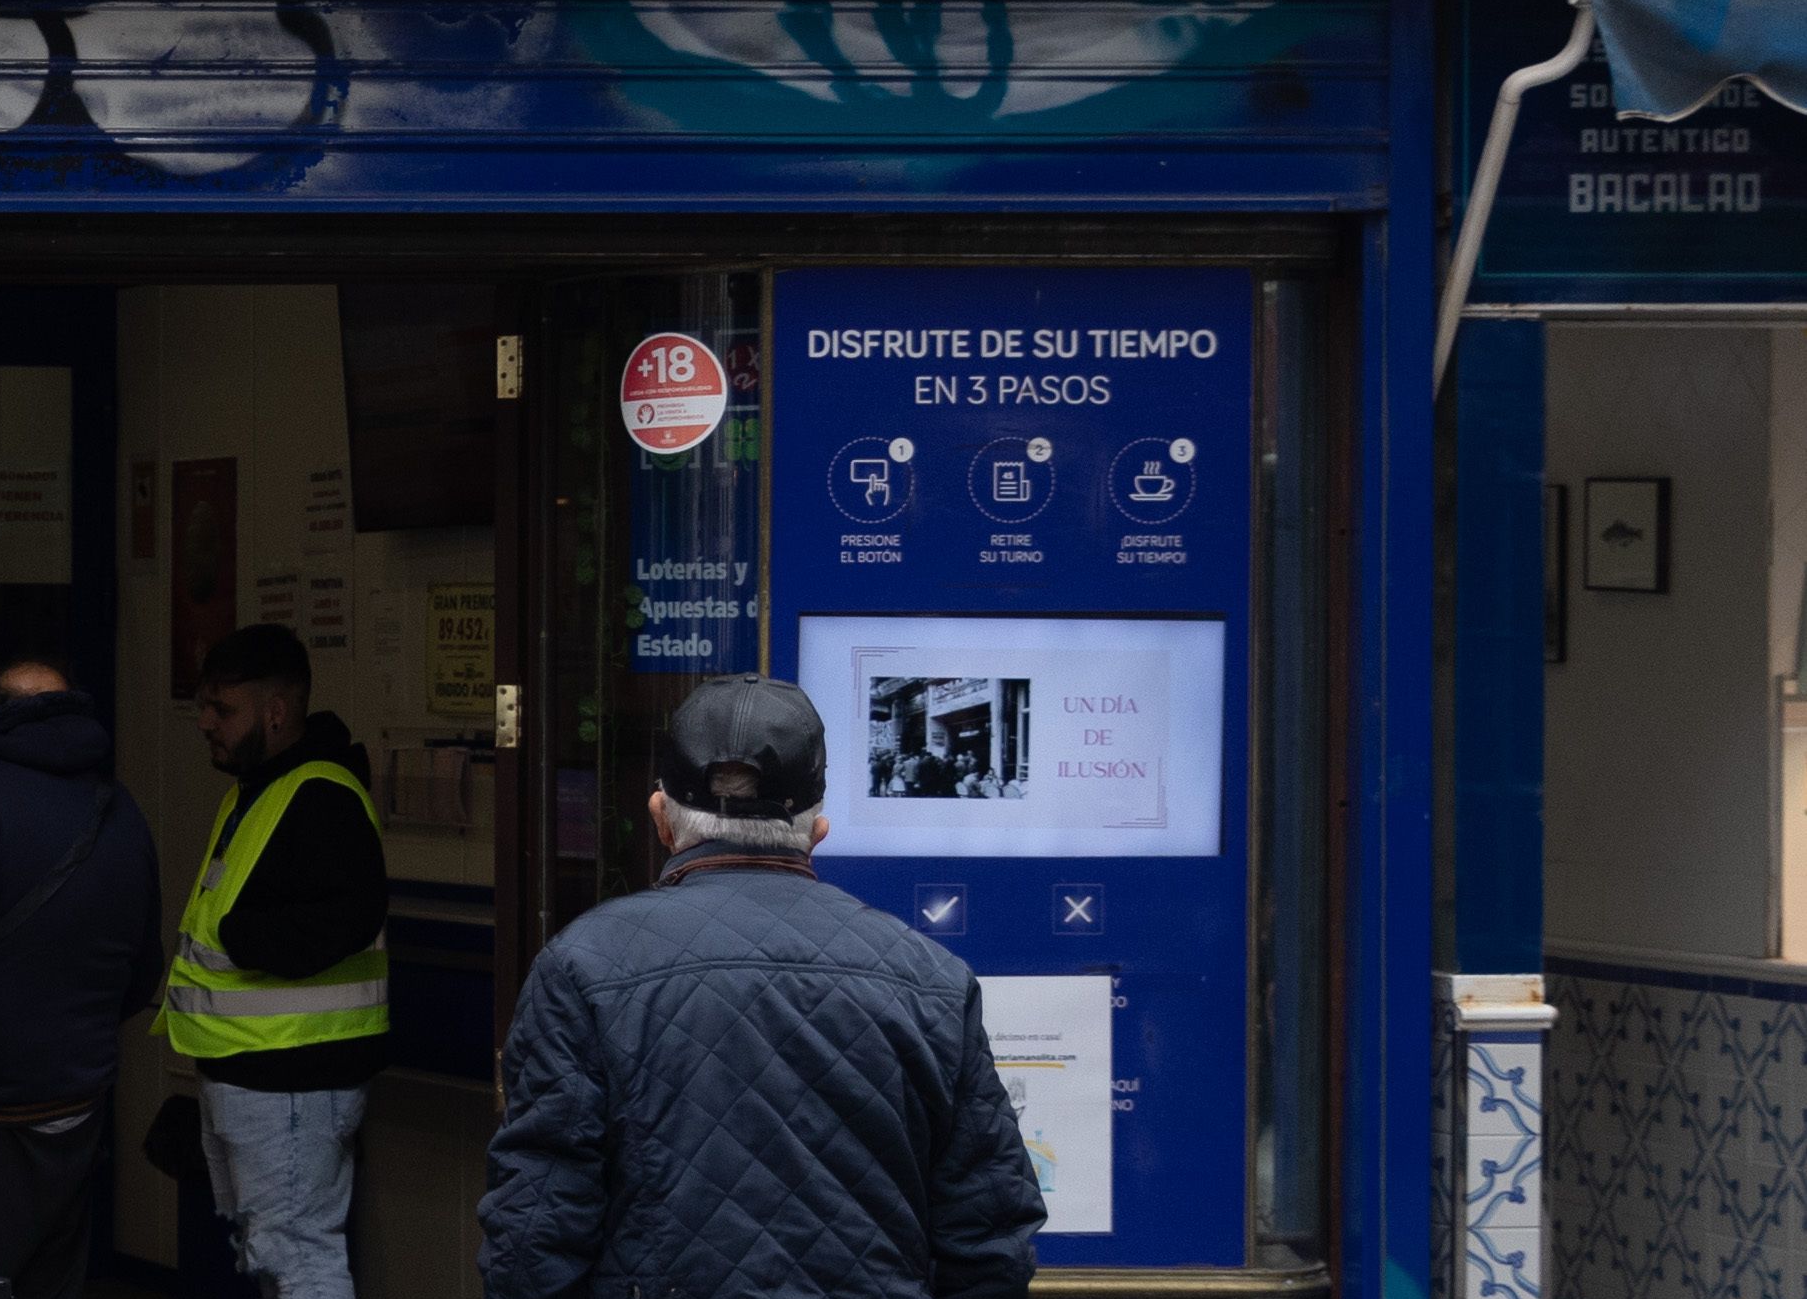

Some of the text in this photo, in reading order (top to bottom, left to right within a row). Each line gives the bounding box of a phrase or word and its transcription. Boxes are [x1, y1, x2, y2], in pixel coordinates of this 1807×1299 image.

[1580, 128, 1751, 153] AUTENTICO
[1568, 173, 1762, 213] BACALAO
[808, 329, 1218, 358] DISFRUTE DE SU TIEMPO
[637, 345, 697, 383] +18
[915, 376, 1110, 405] EN 3 PASOS
[896, 444, 905, 457] 1
[1034, 444, 1044, 457] 2
[1177, 444, 1187, 457] 3
[840, 535, 901, 547] PRESIONE
[990, 535, 1032, 547] RETIRE
[840, 548, 902, 563] EL BOTÓN
[979, 551, 1042, 563] SU TURNO
[1116, 551, 1133, 563] SU
[636, 556, 749, 586] Loterías y
[639, 595, 740, 625] Apuestas
[637, 632, 713, 657] Estado
[1063, 694, 1139, 714] UN DÍA
[1084, 729, 1114, 746] DE
[1057, 759, 1147, 778] ILUSIÓN
